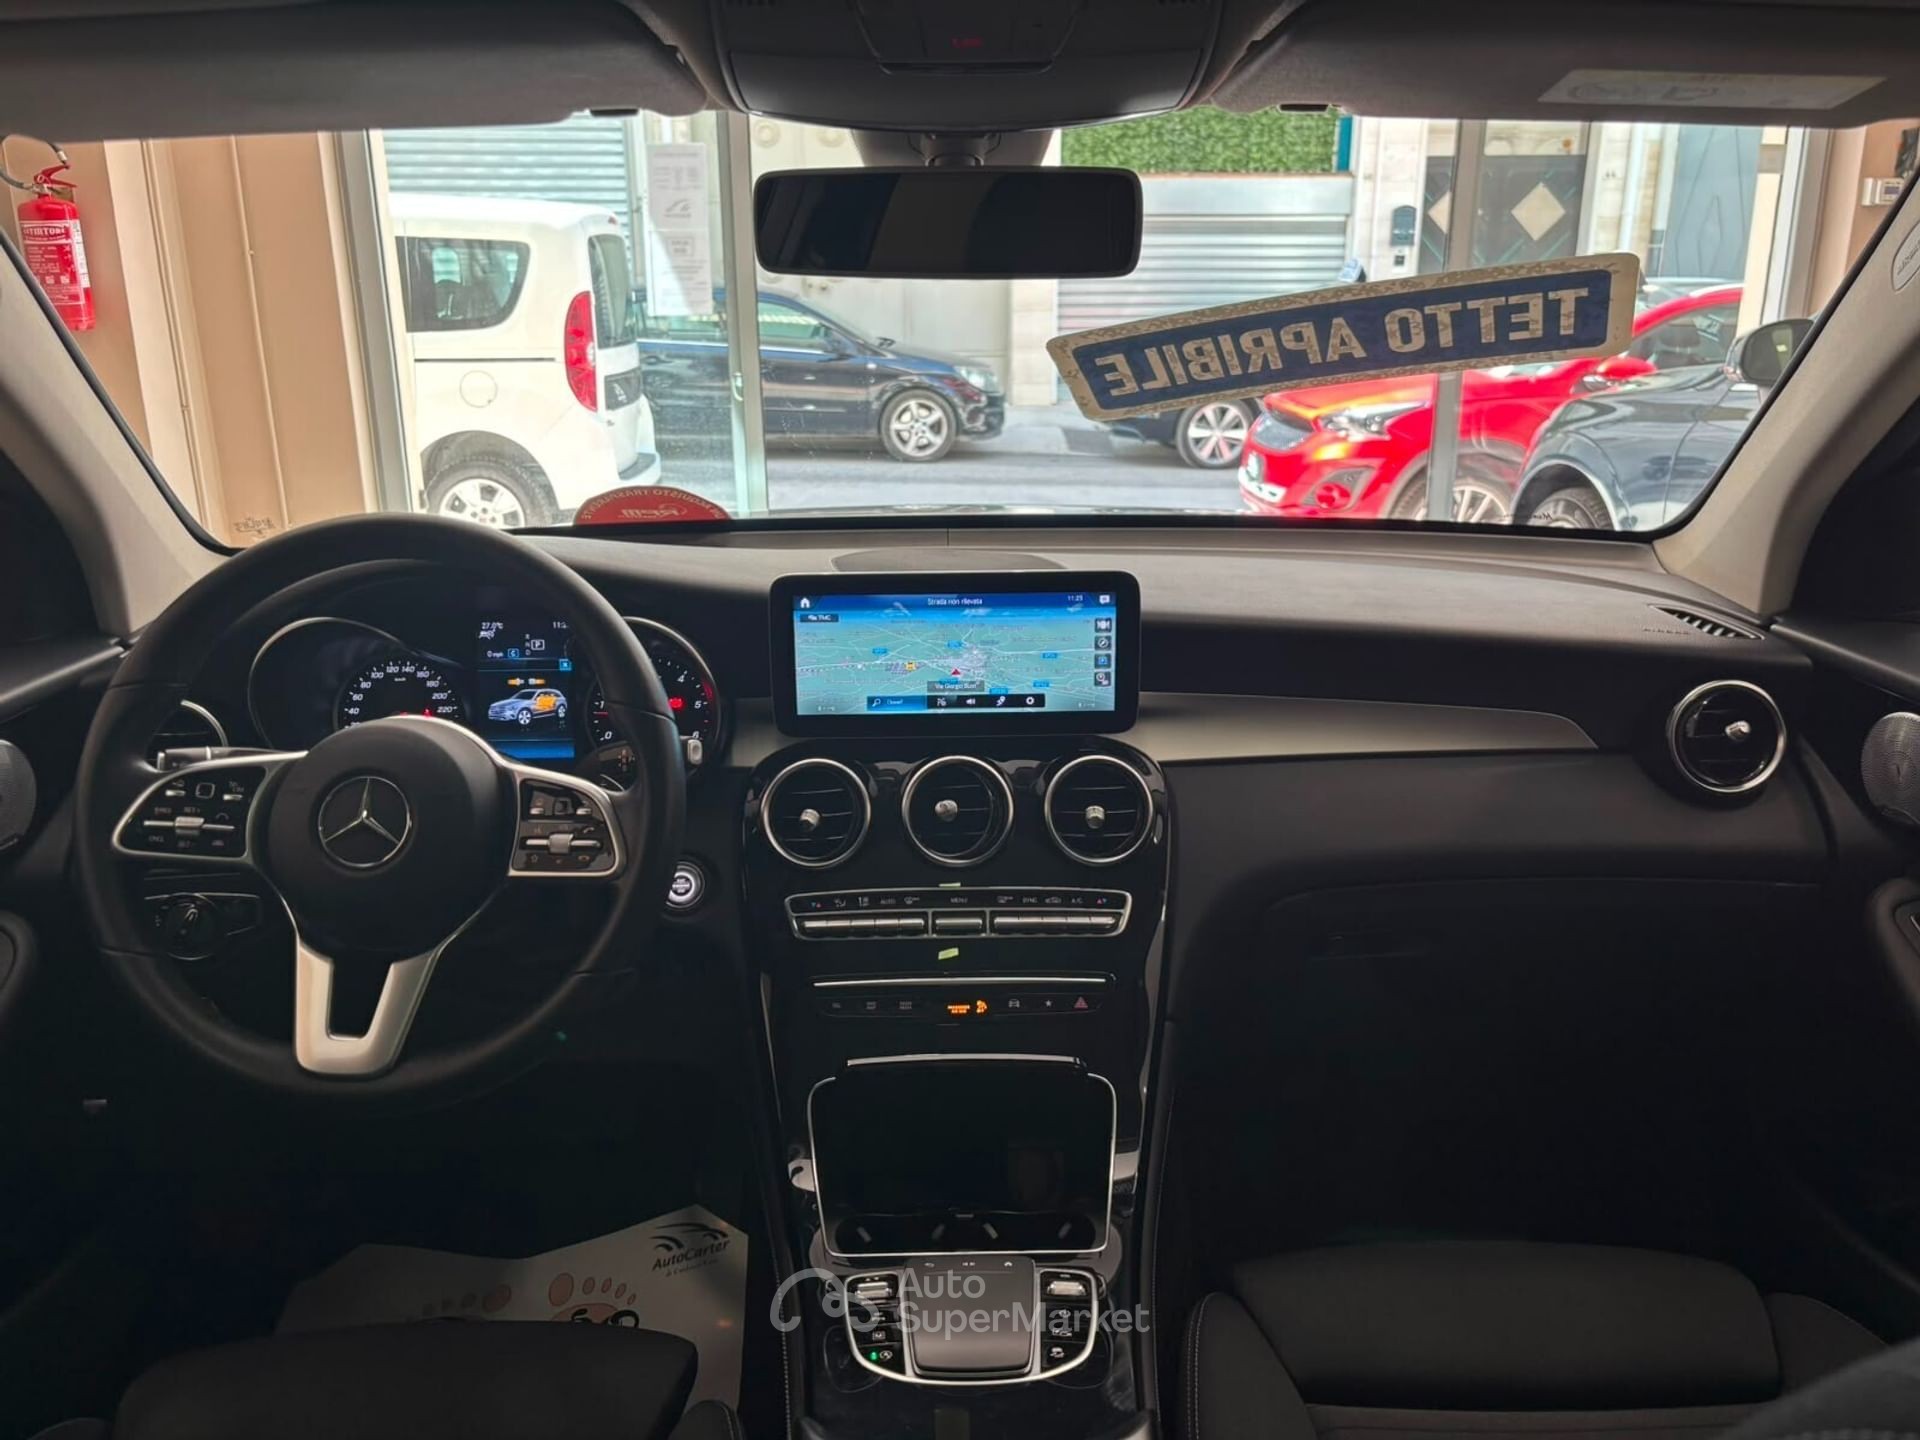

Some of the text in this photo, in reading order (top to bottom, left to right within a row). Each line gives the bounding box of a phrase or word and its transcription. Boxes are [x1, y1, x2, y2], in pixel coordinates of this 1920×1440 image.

[386, 665, 400, 674] 120
[401, 665, 415, 674] 140
[370, 670, 384, 679] 100
[360, 681, 372, 689] 80
[426, 679, 440, 688] 180
[352, 693, 364, 702] 60
[431, 691, 448, 700] 200
[348, 706, 360, 715] 40
[437, 705, 453, 714] 220
[652, 1239, 730, 1272] AutoCarter
